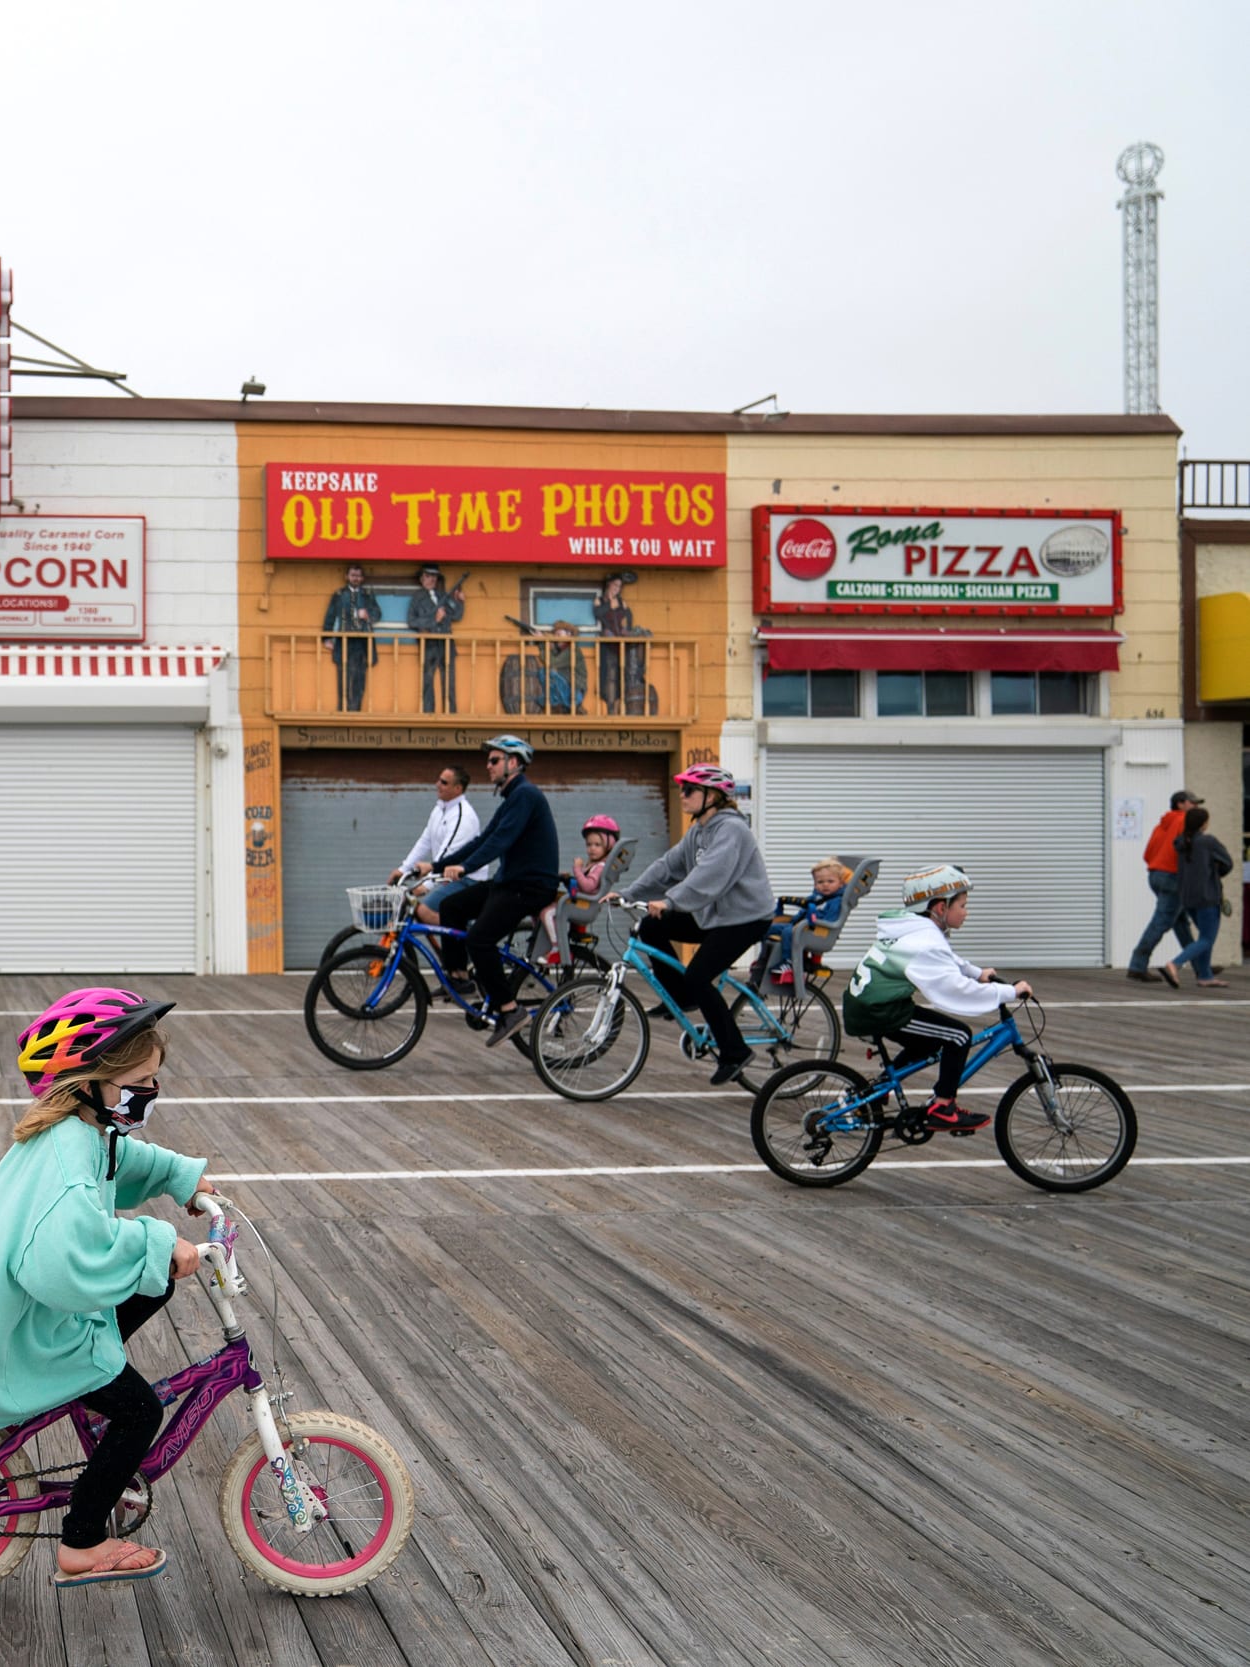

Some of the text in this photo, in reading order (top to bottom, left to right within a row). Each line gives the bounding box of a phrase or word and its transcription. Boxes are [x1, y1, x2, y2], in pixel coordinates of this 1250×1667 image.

[281, 471, 378, 492] KEEPSAKE
[281, 482, 715, 547] OLD TIME PHOTOS
[39, 529, 91, 540] Caramel
[95, 529, 125, 540] Corn
[847, 521, 944, 563] Roma
[23, 542, 57, 551] Since
[569, 537, 716, 558] WHILE YOU WAIT
[903, 545, 1040, 577] PIZZA
[836, 582, 1052, 598] CALZONE STROMBOLI SICILIAN PIZZA
[297, 728, 383, 746] Specializing
[390, 729, 402, 743] in
[407, 728, 446, 747] Large
[542, 729, 613, 746] Children's
[618, 730, 668, 747] Photos
[161, 1386, 215, 1469] AVIGO
